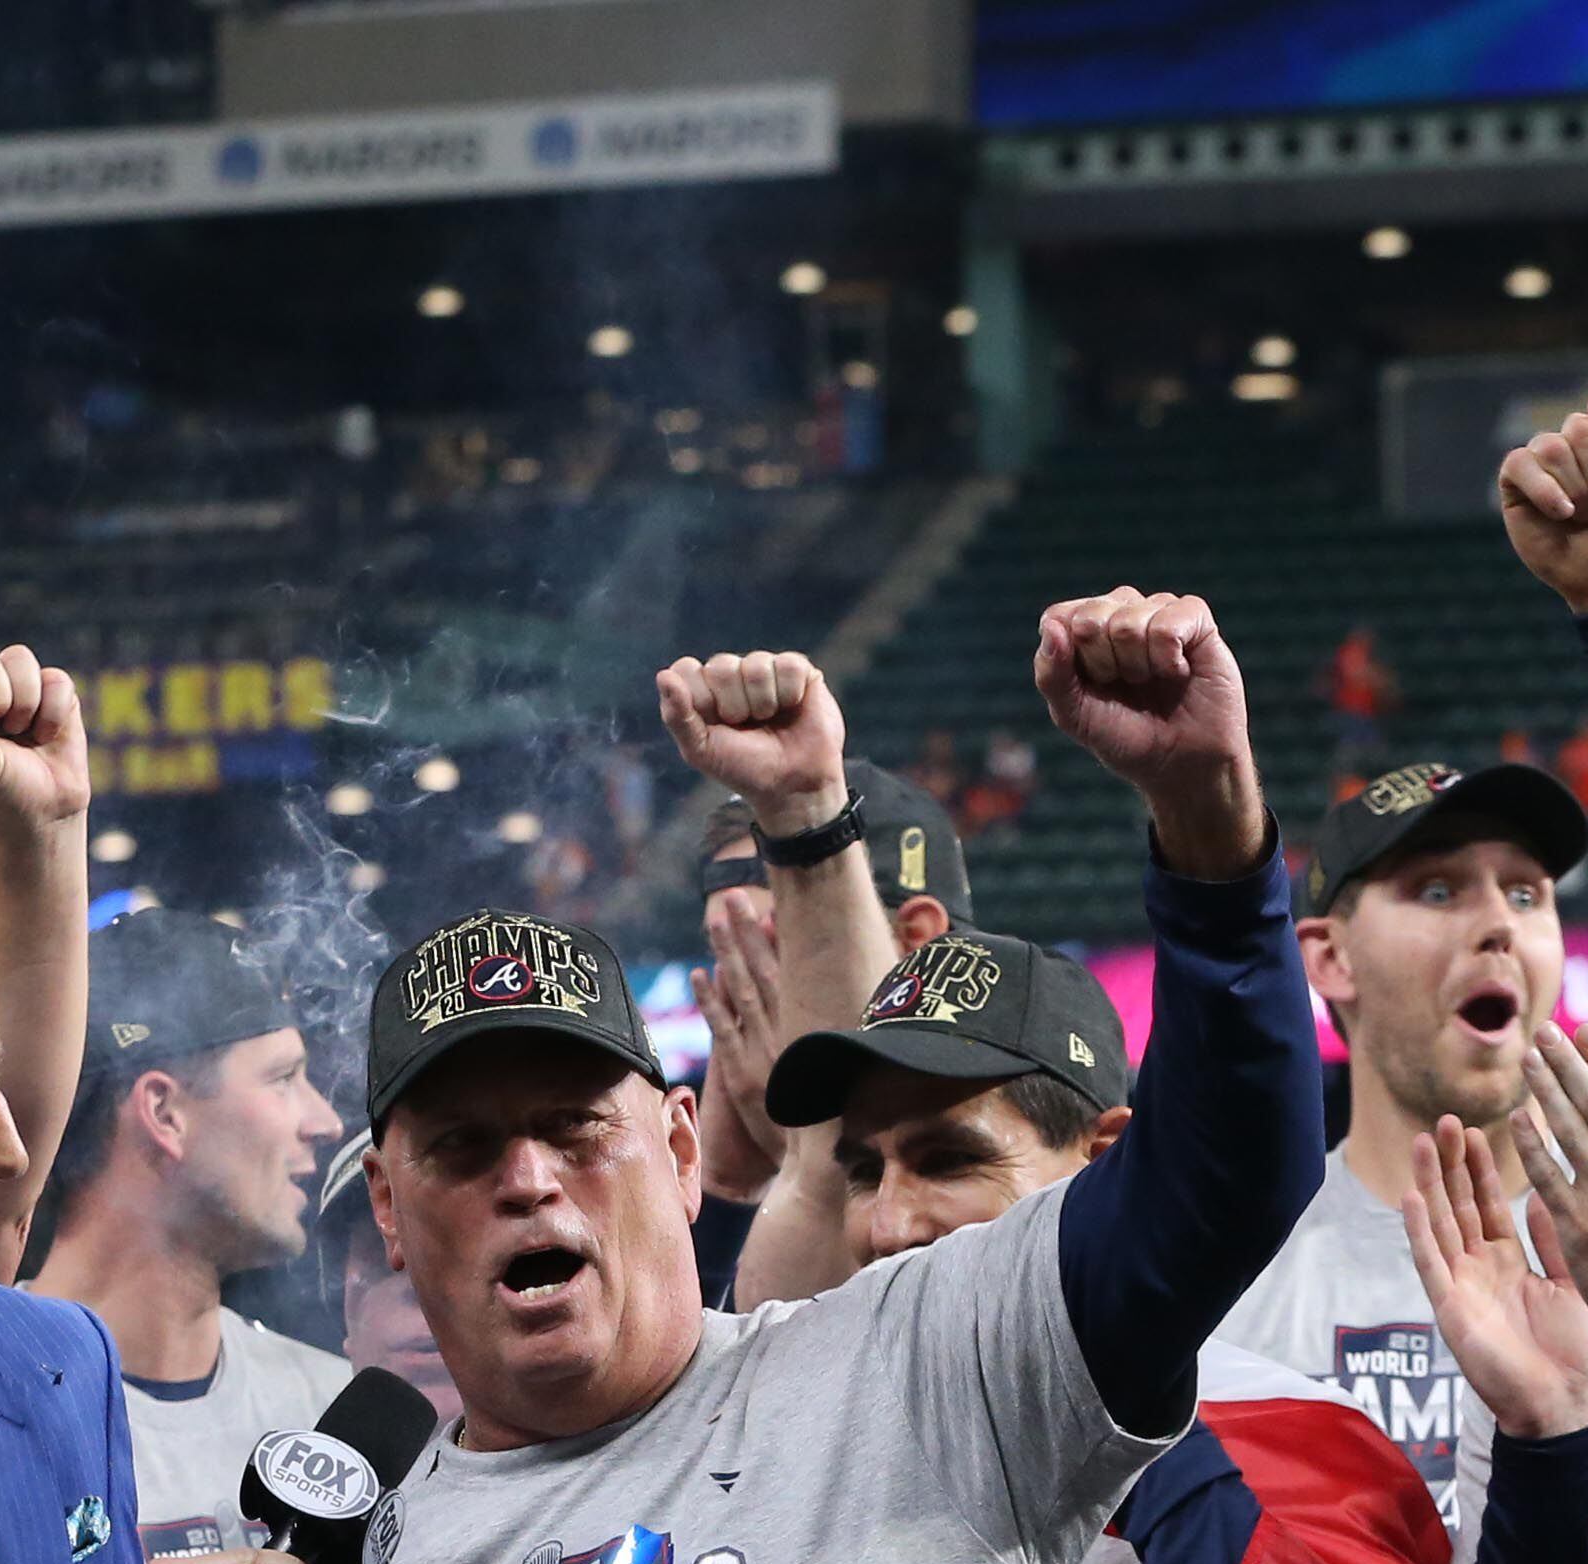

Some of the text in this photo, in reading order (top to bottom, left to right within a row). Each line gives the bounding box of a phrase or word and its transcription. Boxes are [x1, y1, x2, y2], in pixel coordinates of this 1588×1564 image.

[400, 921, 600, 1021] CHAMPS
[445, 991, 466, 1017] 20
[539, 983, 562, 1006] 21
[915, 996, 938, 1016] 21
[1345, 1350, 1429, 1378] WORLD
[280, 1439, 360, 1496] FOX
[272, 1467, 346, 1509] SPORTS
